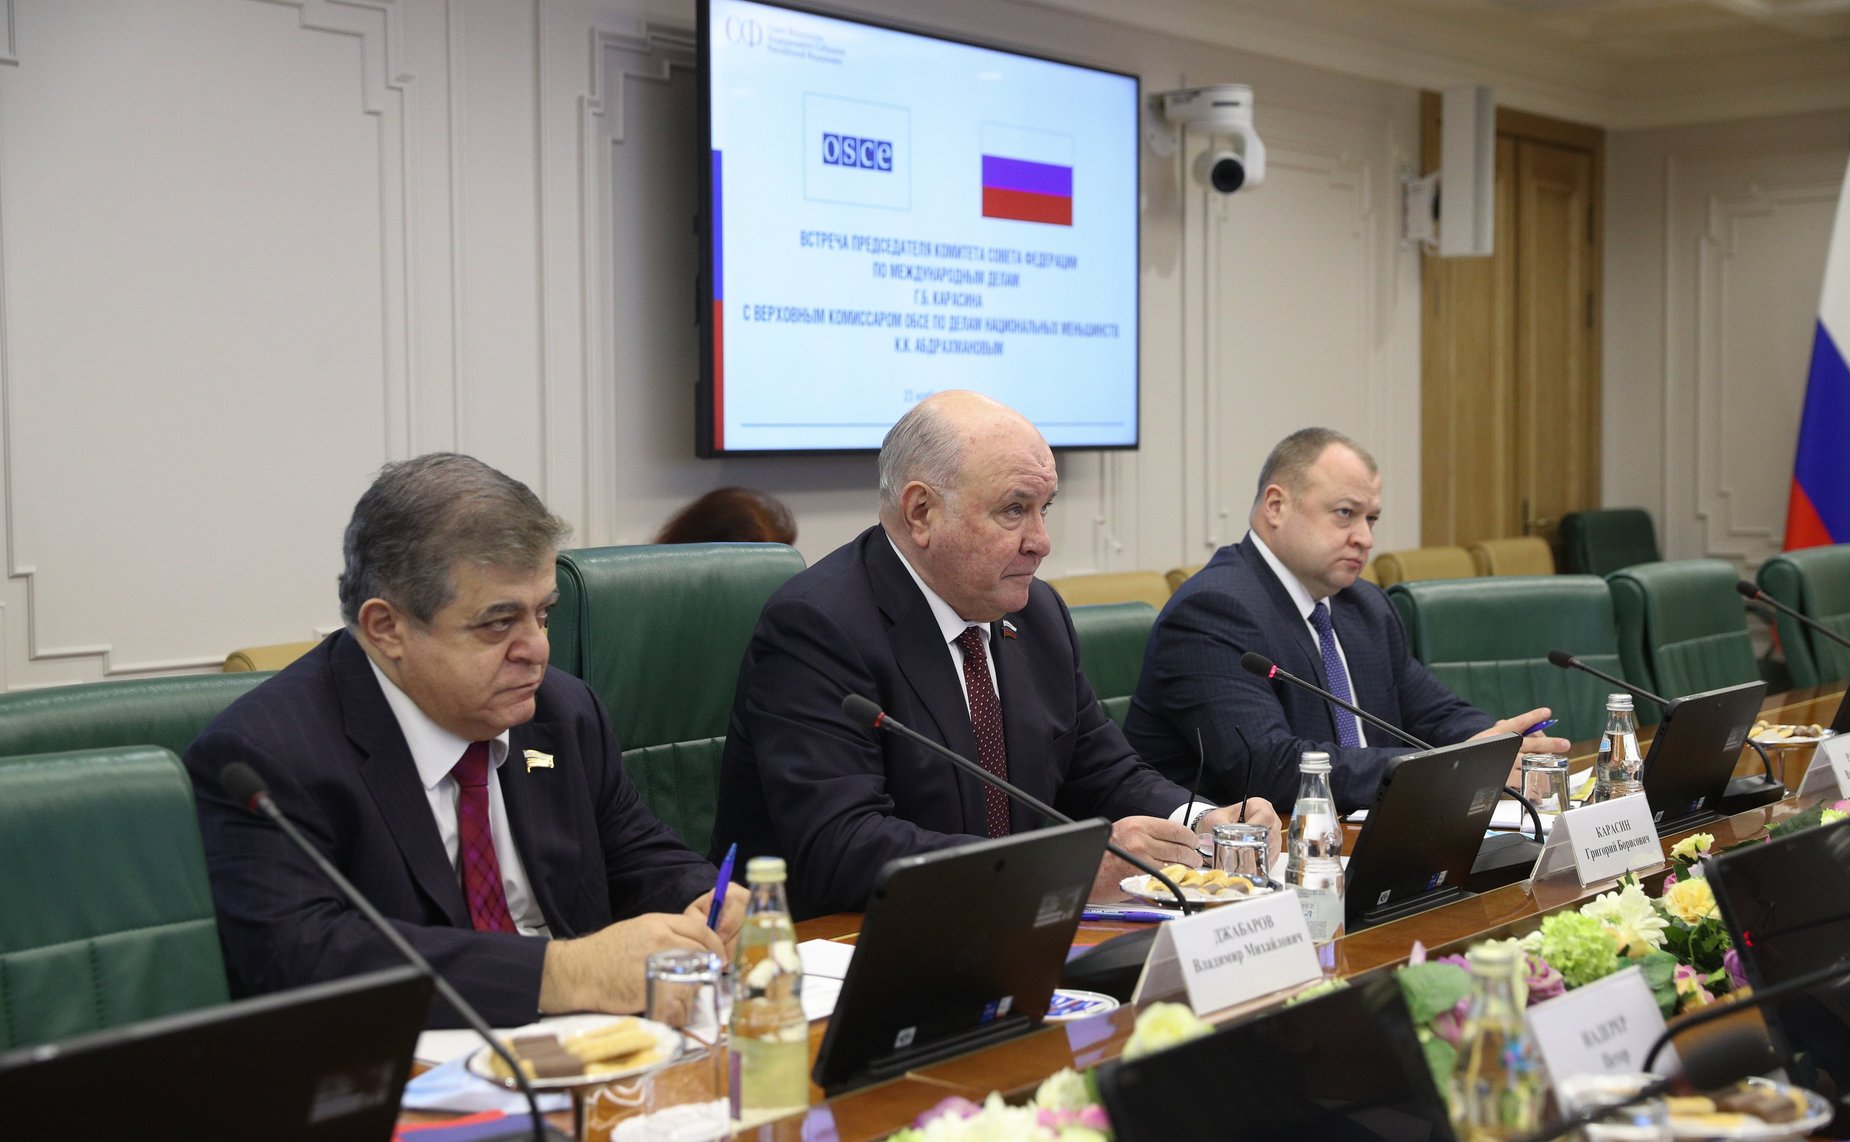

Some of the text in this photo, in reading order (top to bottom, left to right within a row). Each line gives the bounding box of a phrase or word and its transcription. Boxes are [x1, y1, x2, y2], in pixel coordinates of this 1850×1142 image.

[800, 229, 1078, 271] ВСТРЕЧА ПРЕДСЕДАТЕЛЯ КОМИТЕТА СОВЕТА ФЕДЕРАЦИИ
[872, 261, 1020, 289] ПО МЕЖДУНАРОДНЫМ ДЕЛАМ
[932, 290, 983, 308] КАРАСИНА
[743, 304, 1120, 339] С ВЕРХОВНЫМ КОМИССАРОМ ОБСЕ ПО ДЕЛАМ НАЦИОНАЛЬНЫХ МЕНЬШИНСТВ
[915, 338, 1004, 357] АБДРАХМАНОВЫМ
[1595, 819, 1631, 838] КАРАСИН
[1584, 835, 1651, 861] Григорий Борисович
[1213, 915, 1275, 945] ДЖАБАРОВ
[1192, 932, 1304, 973] Владимир Михайлович
